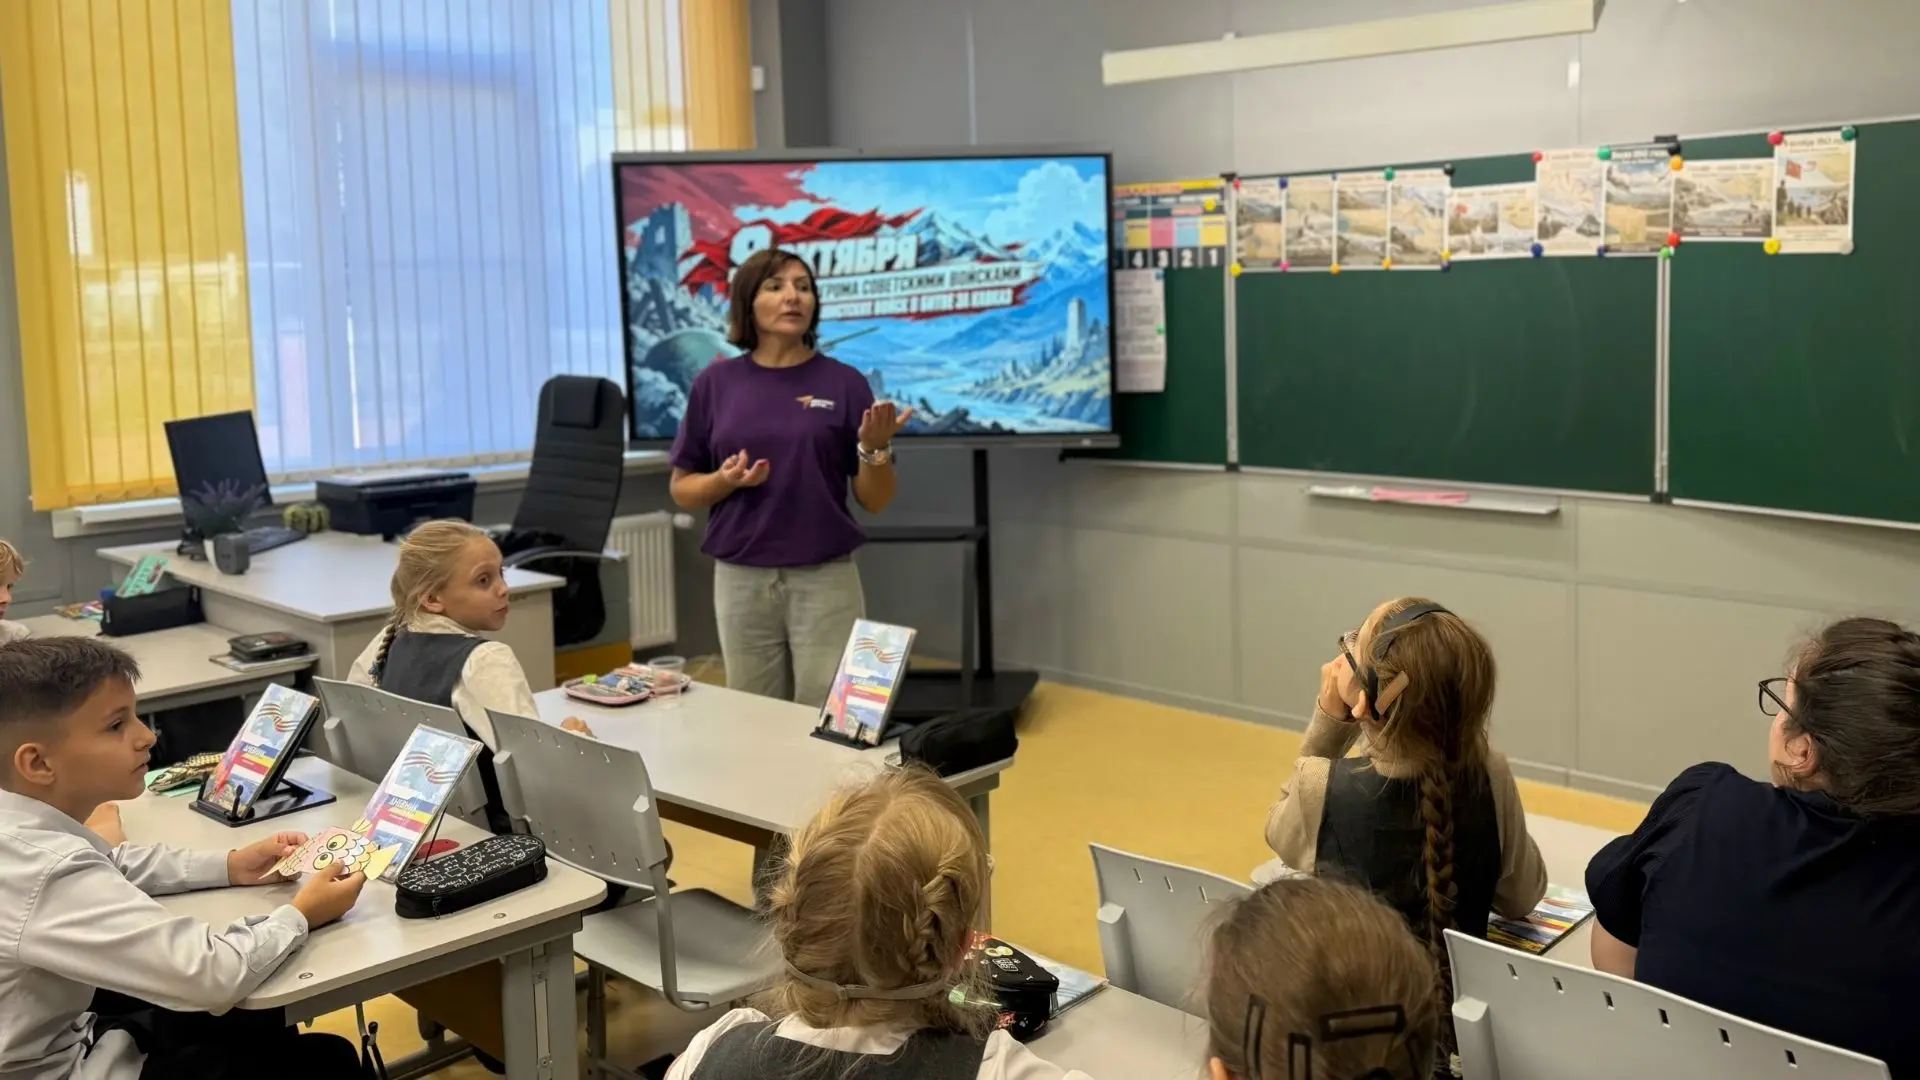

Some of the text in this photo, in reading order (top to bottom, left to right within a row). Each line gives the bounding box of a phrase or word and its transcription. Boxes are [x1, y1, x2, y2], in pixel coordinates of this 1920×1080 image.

[777, 234, 918, 278] КТЯБРЯ
[1132, 248, 1218, 268] 4 3 2 1
[861, 272, 946, 297] СОВЕТСКИМИ
[949, 265, 1022, 287] ВОЙСКАМИ
